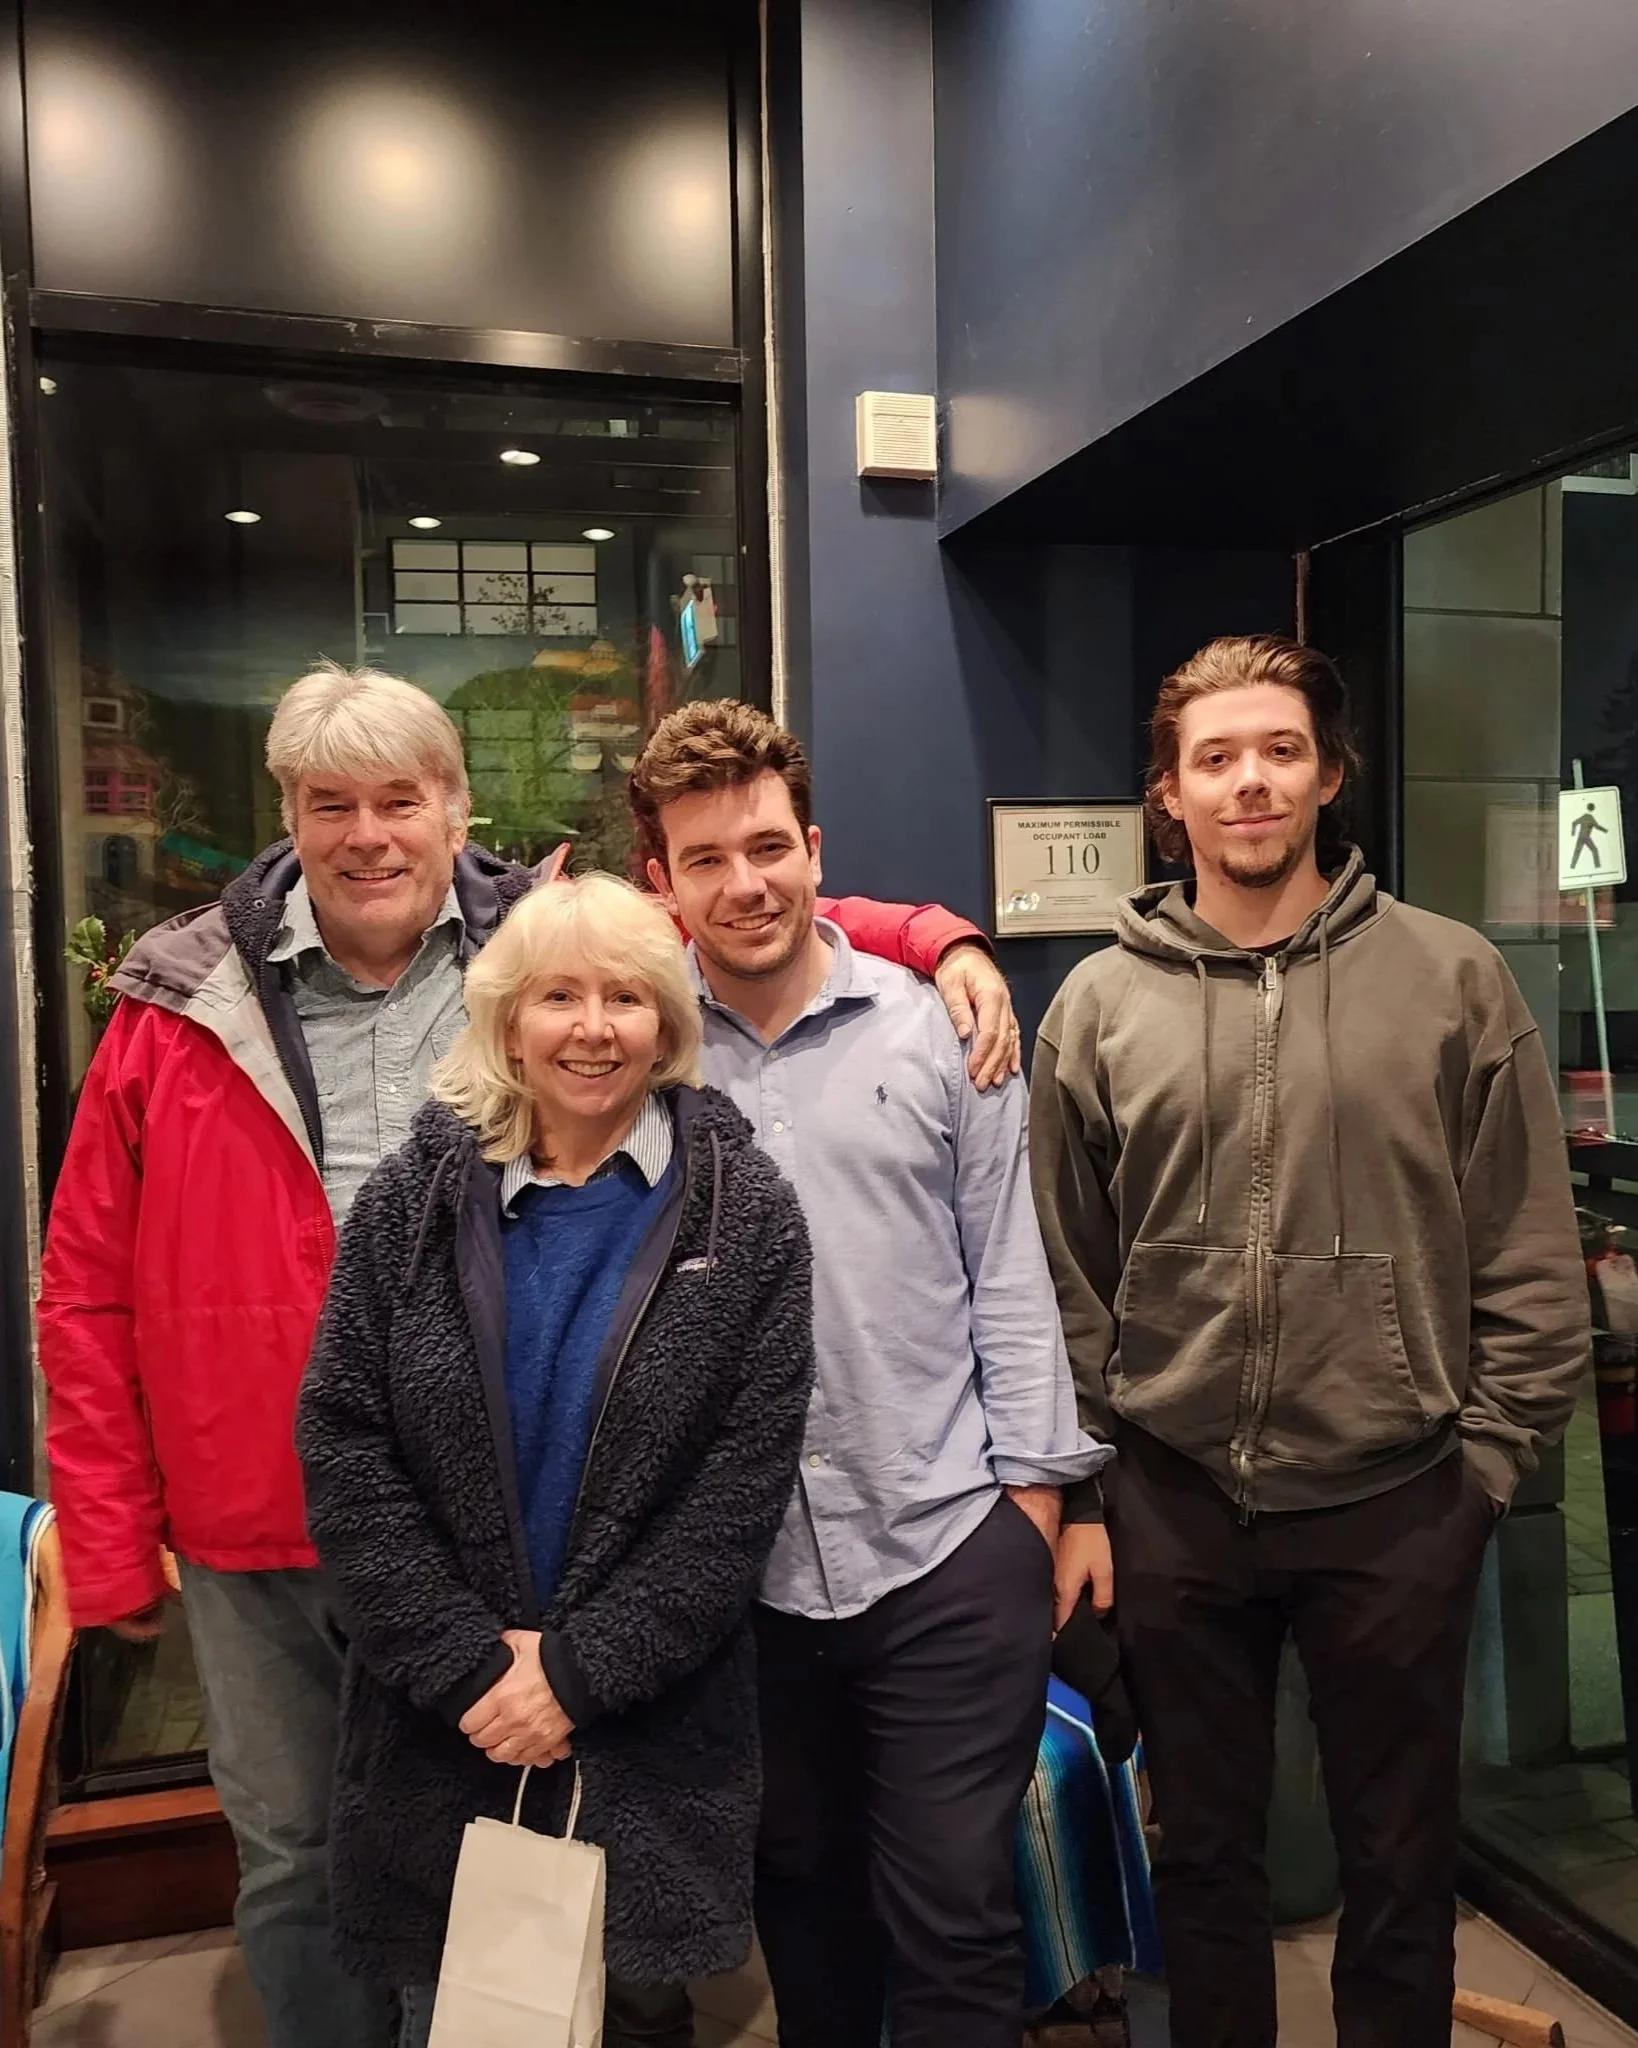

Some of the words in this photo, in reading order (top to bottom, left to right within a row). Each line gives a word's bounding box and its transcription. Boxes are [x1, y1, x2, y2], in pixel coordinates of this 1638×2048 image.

[1018, 821, 1060, 829] MAXIMUM
[1064, 820, 1121, 828] PERMISSIBLE
[1033, 832, 1080, 841] OCCUPANT
[1083, 832, 1106, 840] LOAD
[1044, 843, 1100, 875] 110
